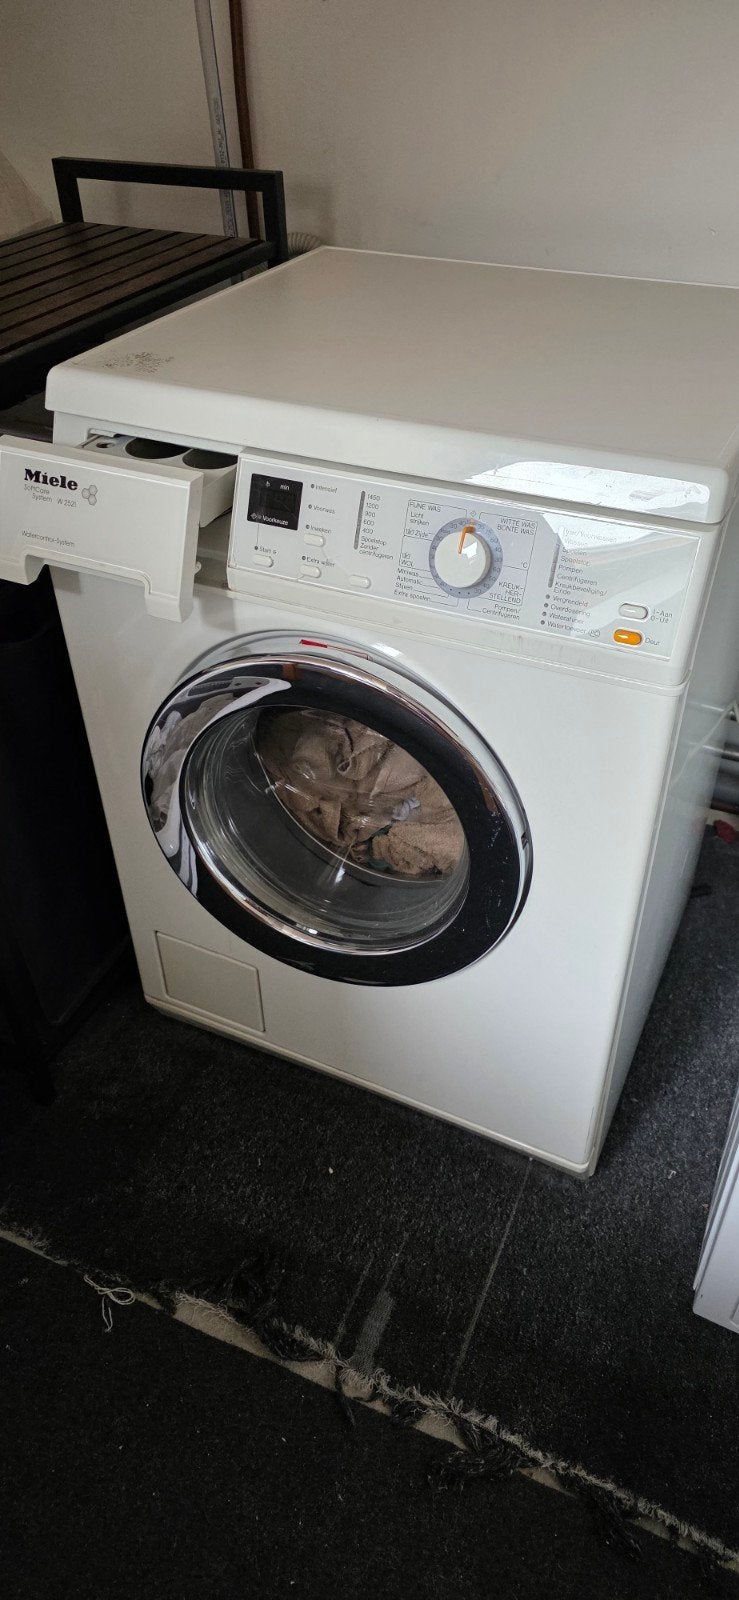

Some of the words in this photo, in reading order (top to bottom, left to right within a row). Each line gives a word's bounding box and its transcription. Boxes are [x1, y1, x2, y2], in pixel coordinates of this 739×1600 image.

[24, 468, 78, 490] Miele
[24, 484, 50, 494] SoftCare
[32, 493, 53, 504] System
[63, 499, 77, 508] 2521
[313, 505, 335, 514] Voorwas
[366, 502, 379, 510] 1200
[427, 504, 441, 513] WAS
[262, 515, 289, 526] Voorkeuze
[500, 517, 519, 527] WITTE
[521, 520, 536, 529] WAS
[362, 527, 374, 535] 400
[497, 524, 518, 534] BONTE
[520, 528, 535, 536] WAS
[21, 530, 75, 547] Watercontrol-System
[259, 546, 271, 554] Start
[359, 542, 380, 551] Zonder
[558, 565, 583, 574] Pompen
[556, 573, 598, 586] Centrifugeren
[498, 581, 524, 590] KREUK-
[553, 586, 571, 595] Einde
[489, 592, 521, 604] STELLEND
[553, 595, 589, 608] Vergrendeld
[481, 607, 520, 620] Centrifugeren
[645, 637, 661, 646] Deur
